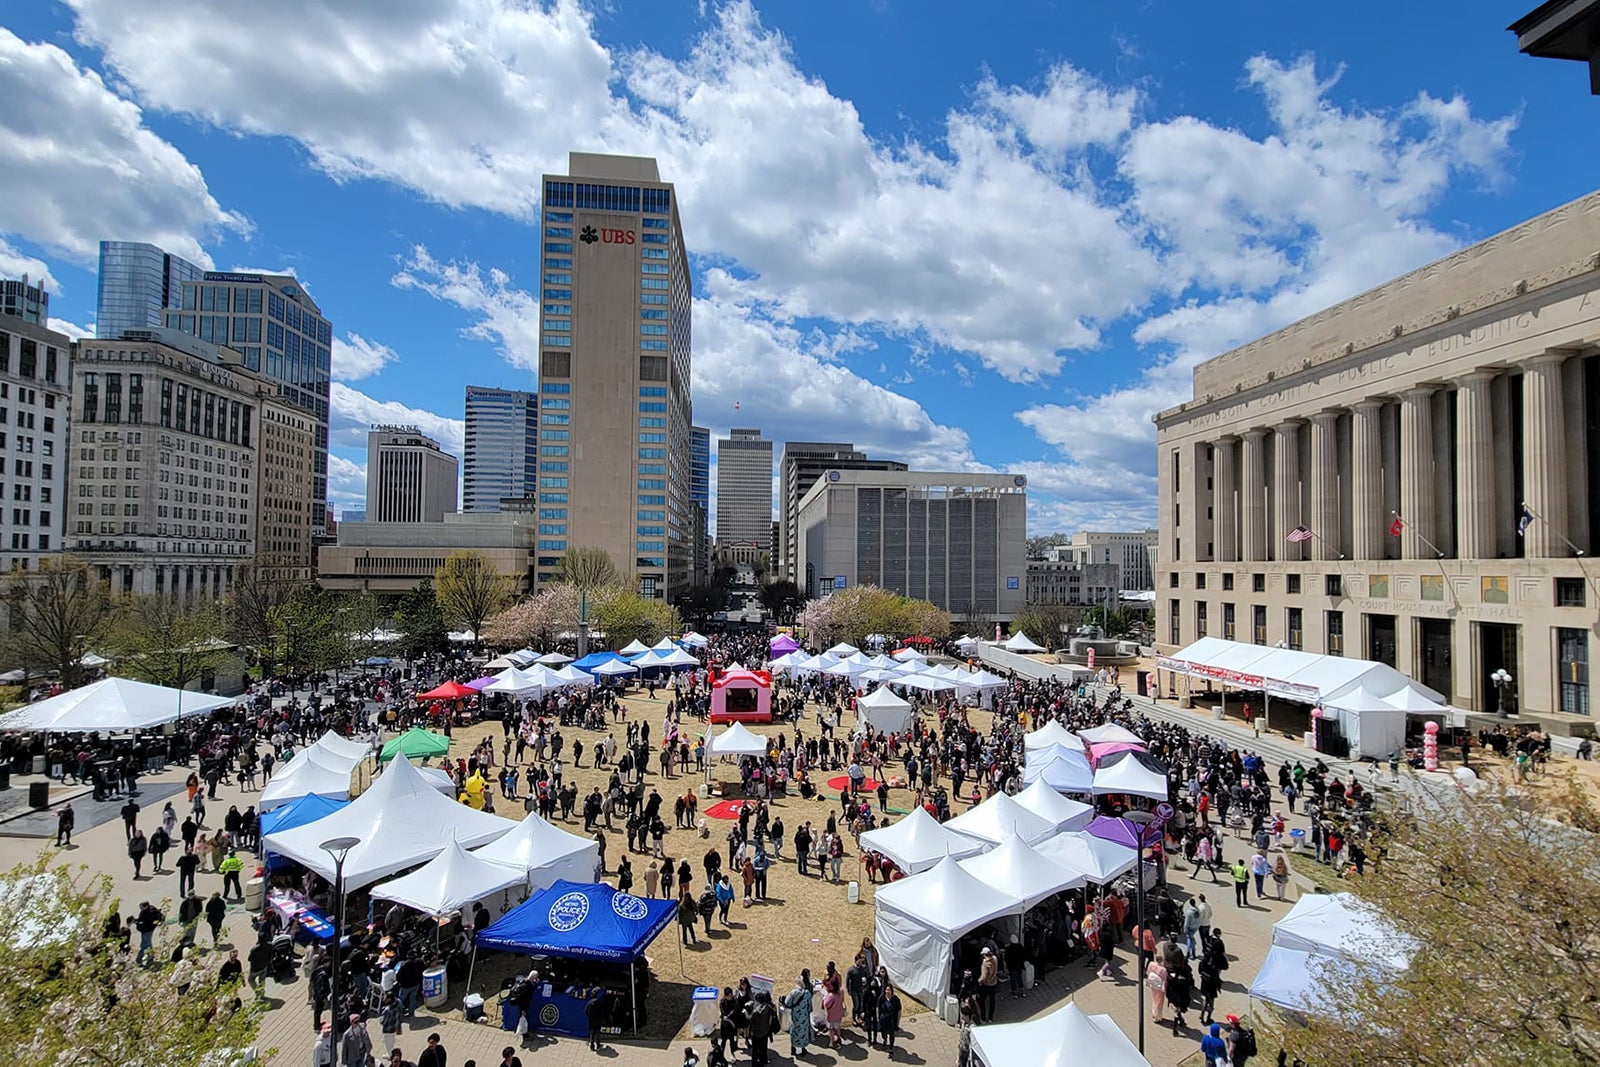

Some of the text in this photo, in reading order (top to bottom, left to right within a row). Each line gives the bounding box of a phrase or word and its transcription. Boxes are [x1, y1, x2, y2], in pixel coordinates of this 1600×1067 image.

[601, 228, 635, 245] UBS
[1338, 356, 1395, 384] PUBLIC
[1427, 313, 1531, 361] BUILDING
[1359, 600, 1390, 610] COURT
[1393, 601, 1424, 613] HOUSE
[1489, 607, 1523, 619] HALL
[557, 906, 581, 915] POLICE
[510, 939, 543, 950] Community
[543, 943, 570, 953] Outreach
[583, 947, 621, 958] Partnerships
